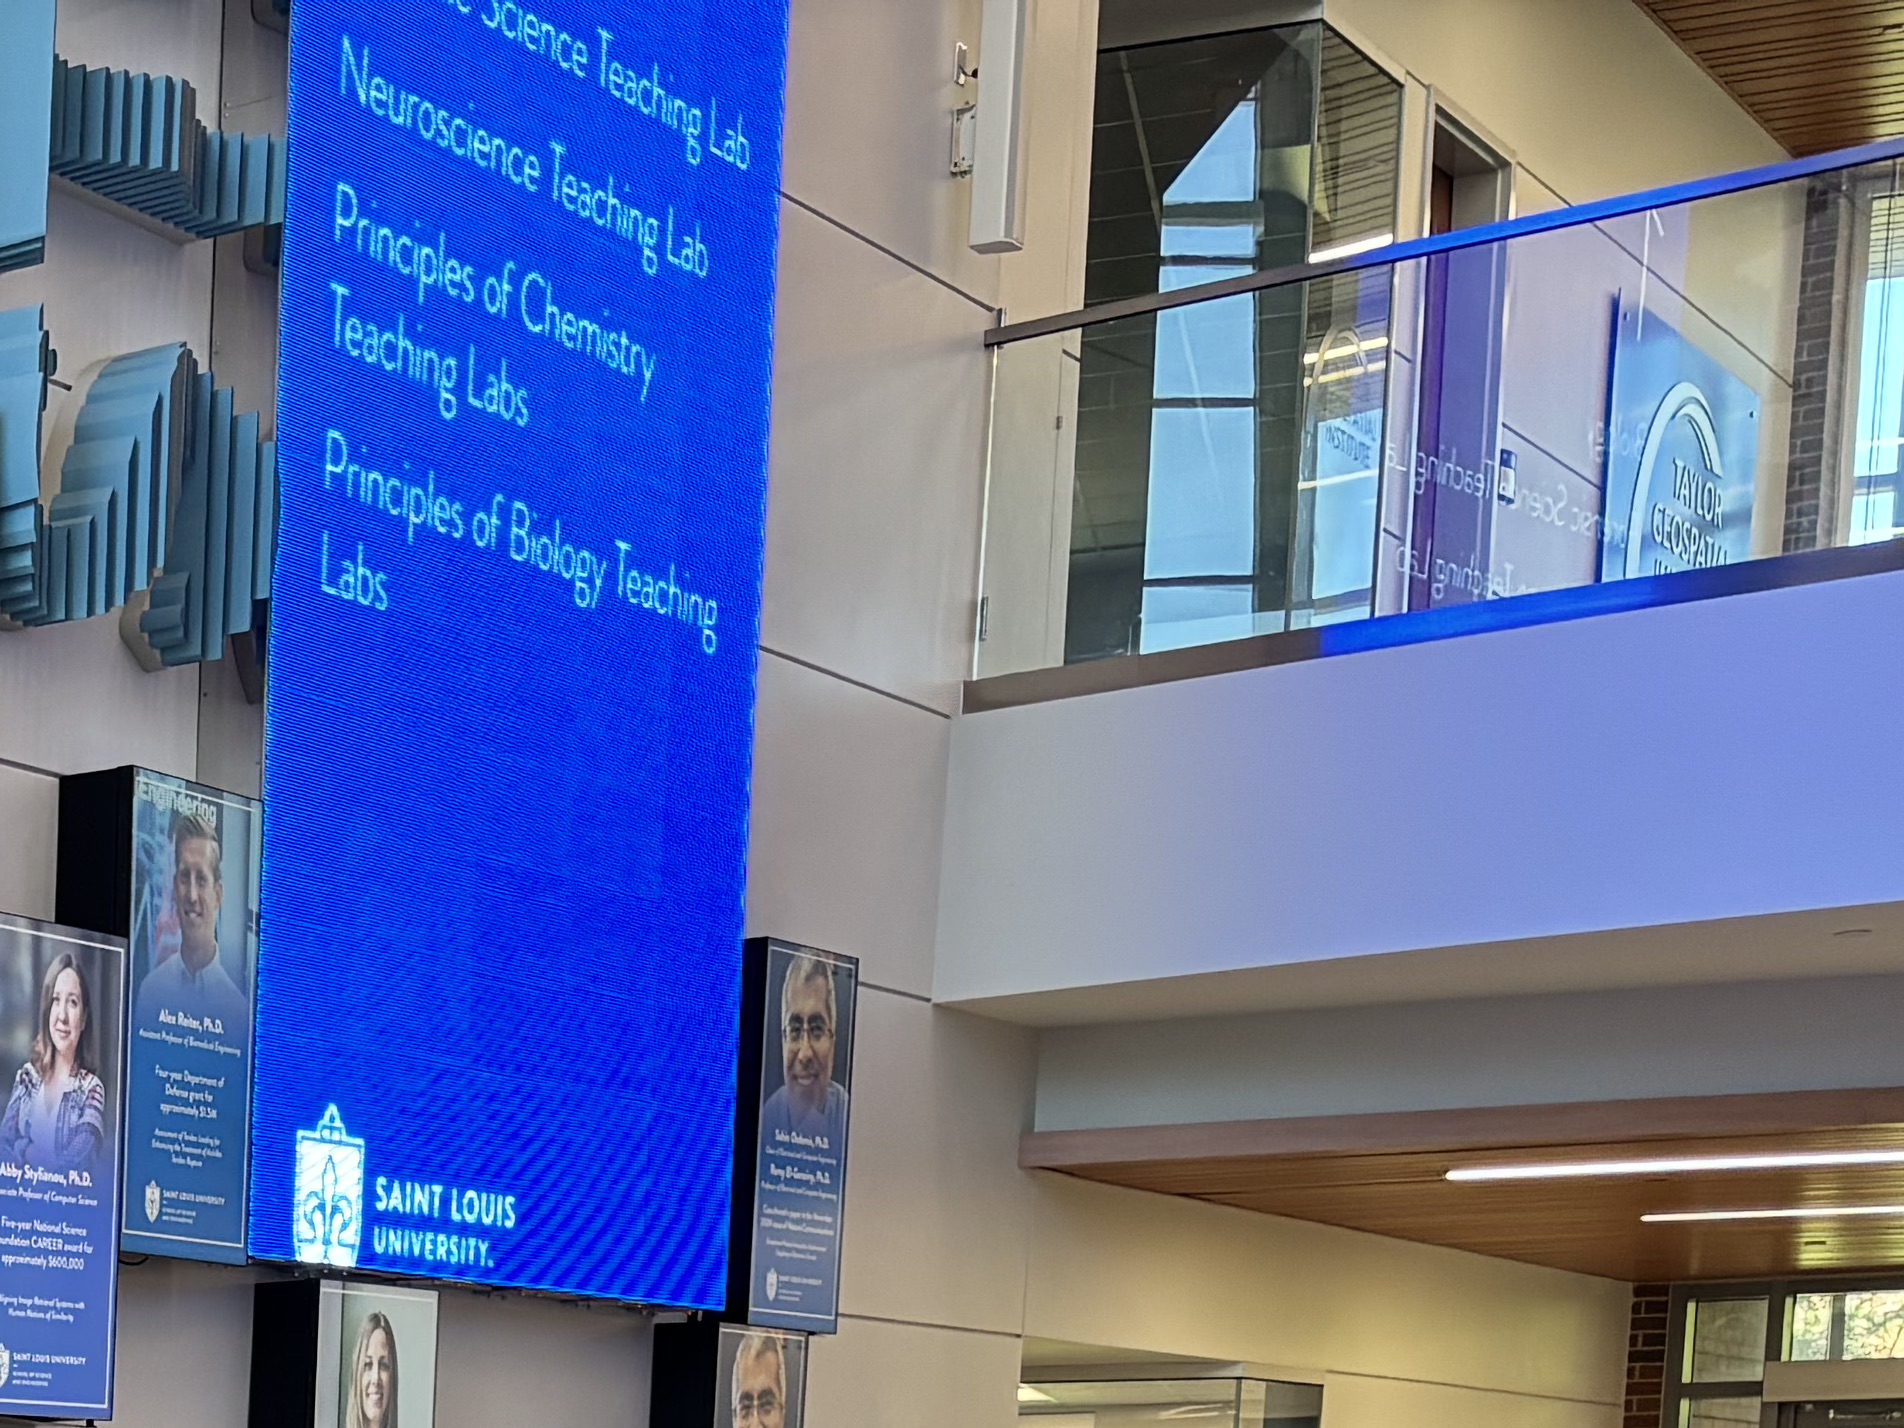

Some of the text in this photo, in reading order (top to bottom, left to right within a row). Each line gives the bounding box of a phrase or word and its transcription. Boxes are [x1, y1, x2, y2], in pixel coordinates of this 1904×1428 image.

[597, 26, 702, 165] Teaching
[709, 97, 750, 171] Lab
[340, 34, 709, 278] Neuroscience Teaching Lab
[334, 183, 655, 402] Principles of Chemistry
[329, 282, 530, 427] Teaching Labs
[1672, 457, 1723, 530] TAYLOR
[321, 531, 388, 611] Labs
[325, 429, 718, 656] Principles of Biology Teaching
[0, 1162, 22, 1183] Abby
[69, 1170, 92, 1186] Ph.D.
[375, 1176, 517, 1229] SAINT LOUIS
[31, 1235, 63, 1250] CAREER
[34, 1220, 61, 1234] National
[63, 1223, 87, 1236] Science
